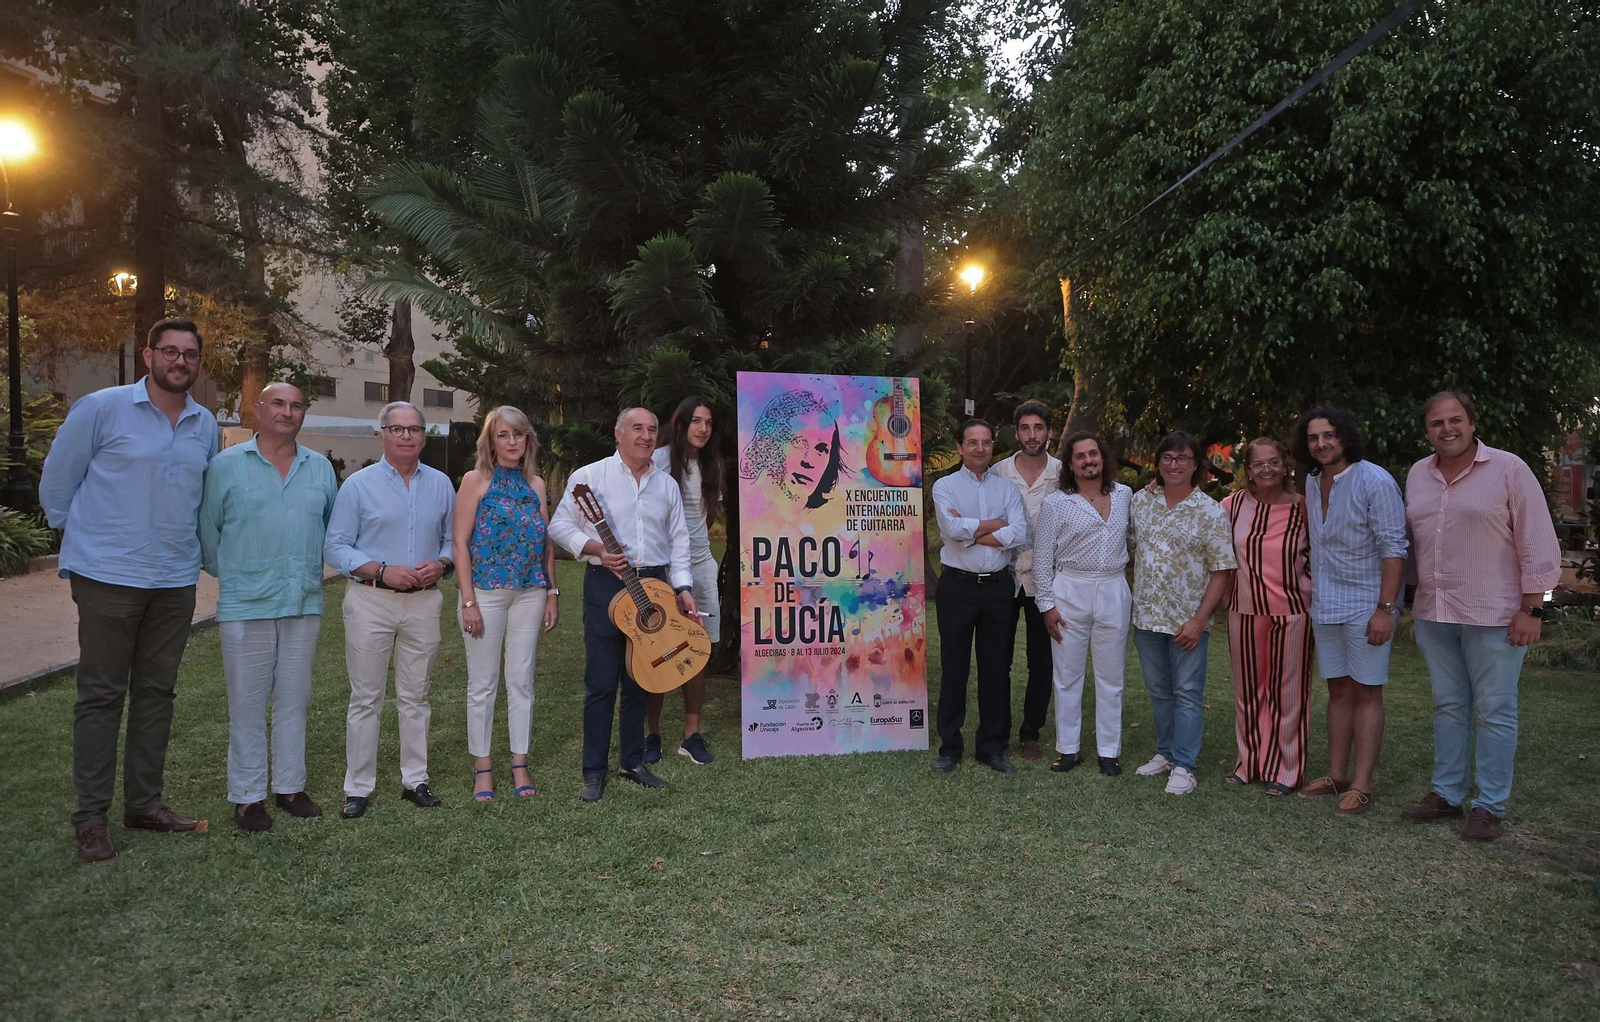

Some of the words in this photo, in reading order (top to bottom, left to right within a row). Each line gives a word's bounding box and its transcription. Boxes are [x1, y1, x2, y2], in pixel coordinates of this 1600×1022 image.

[846, 490, 852, 501] X
[854, 490, 908, 501] ENCUENTRO
[846, 505, 918, 516] INTERNACIONAL
[847, 519, 858, 531] DE
[861, 519, 905, 531] GUITARRA
[753, 536, 841, 578] PACO
[775, 582, 795, 603] DE
[754, 597, 845, 644] LUCÍA
[755, 649, 786, 657] ALGECIRAS
